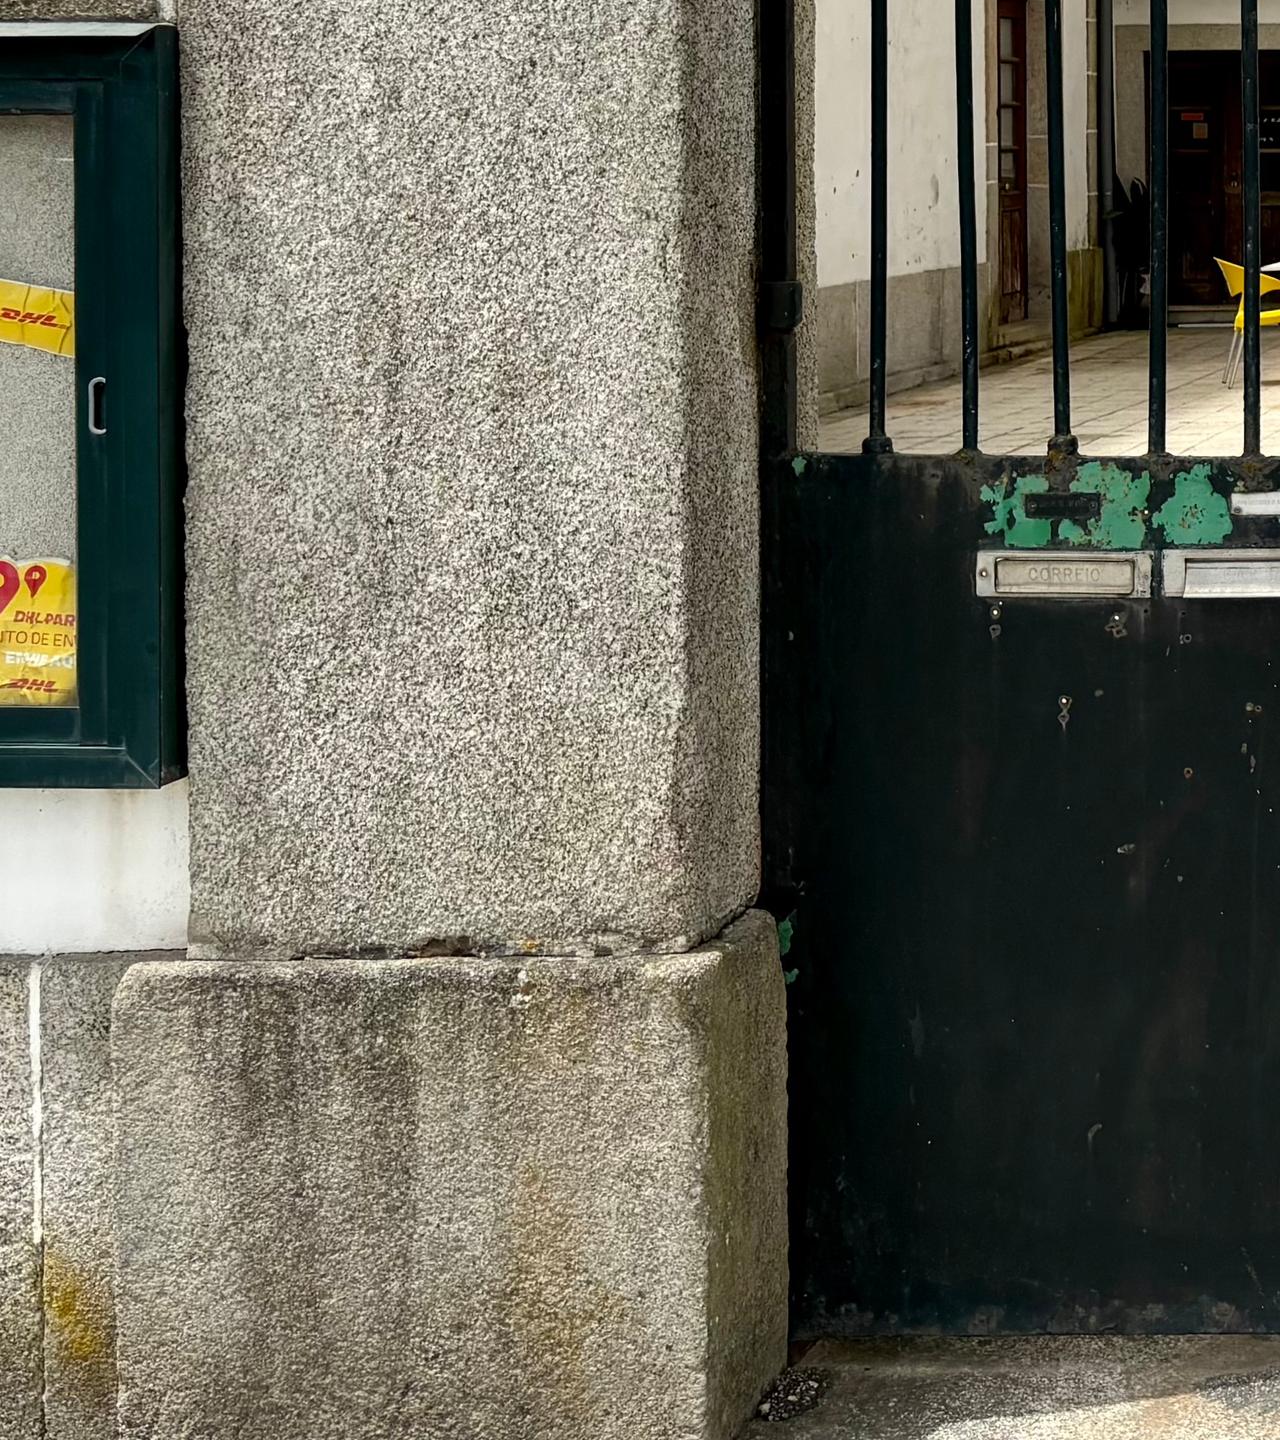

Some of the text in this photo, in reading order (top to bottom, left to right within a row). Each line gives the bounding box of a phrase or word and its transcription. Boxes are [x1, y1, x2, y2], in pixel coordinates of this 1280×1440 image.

[0, 307, 58, 329] DHL
[1028, 566, 1101, 582] CORREIO
[31, 631, 50, 647] DE
